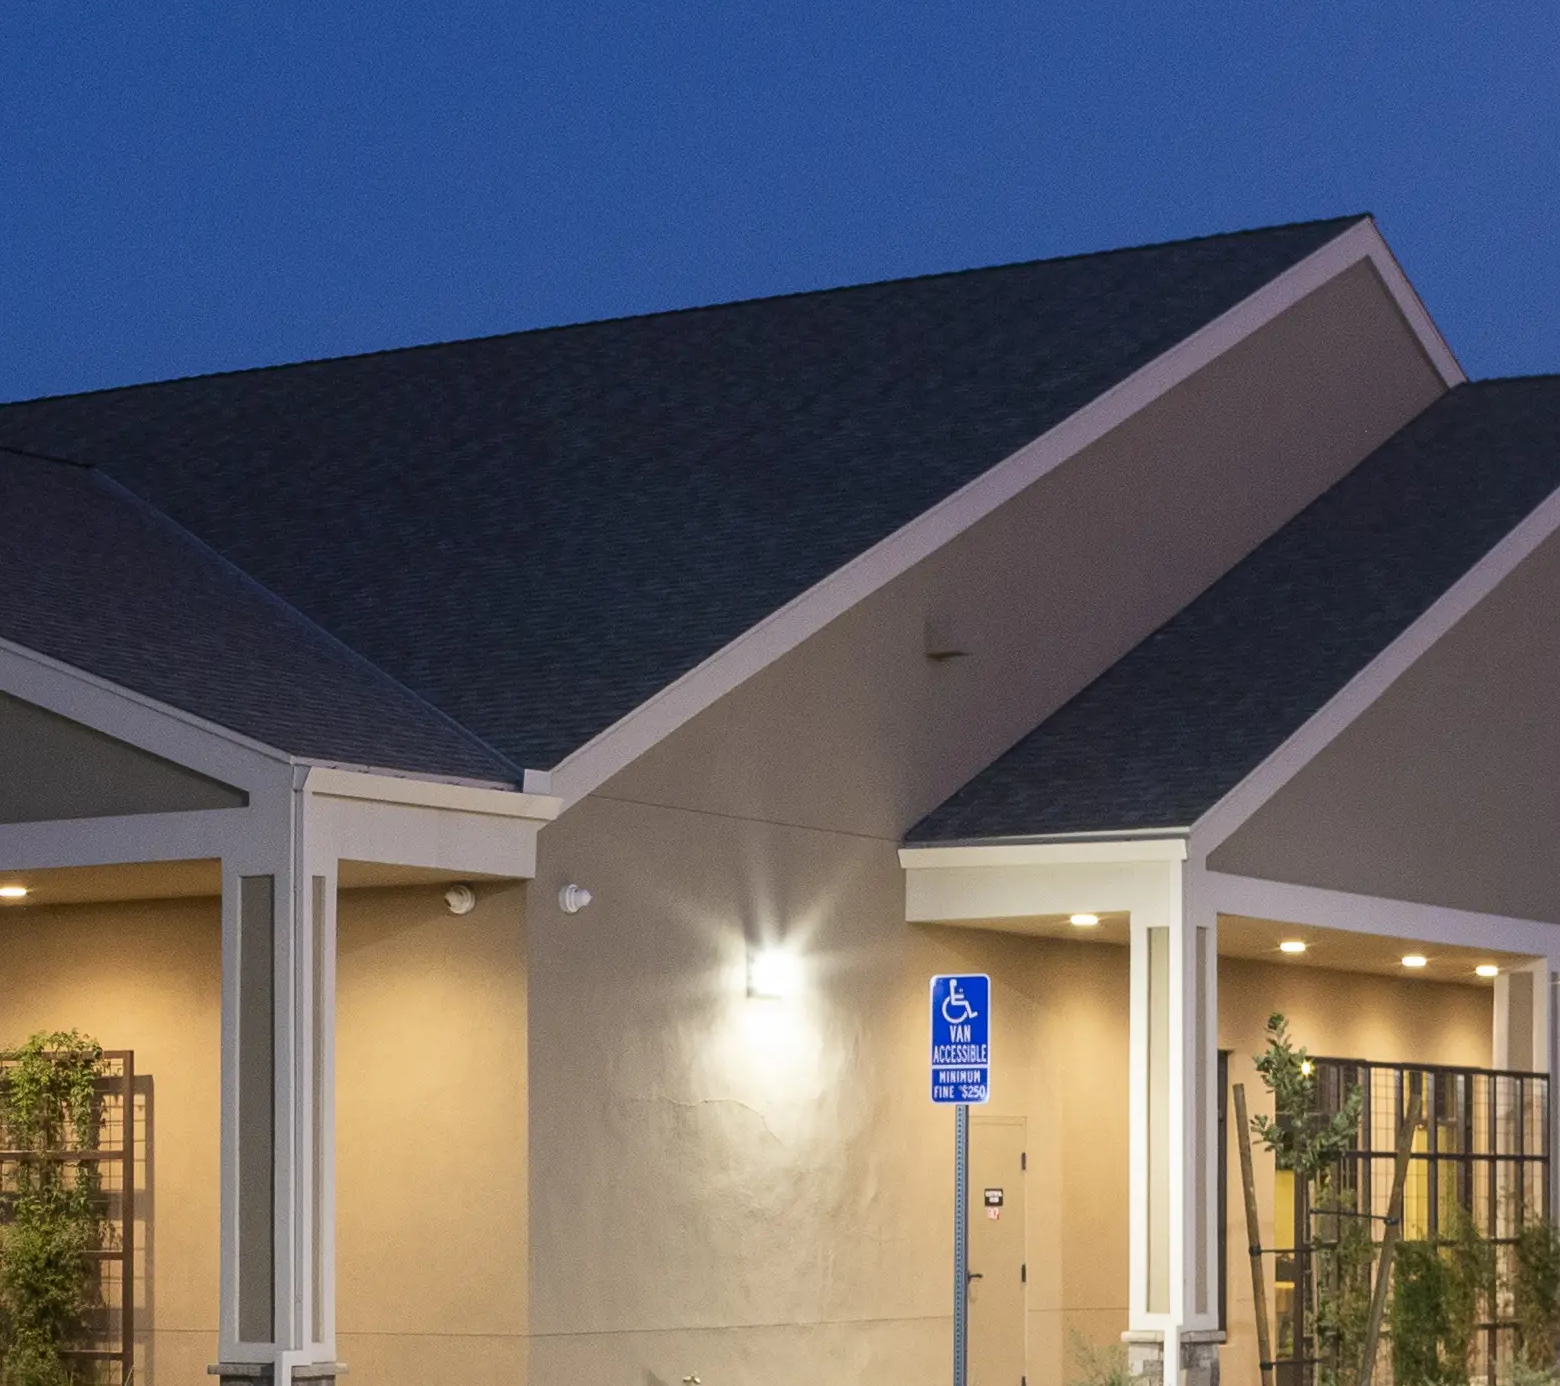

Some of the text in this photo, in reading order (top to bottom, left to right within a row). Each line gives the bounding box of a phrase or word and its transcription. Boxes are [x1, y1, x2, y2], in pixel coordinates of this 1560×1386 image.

[949, 1024, 971, 1043] VAN
[933, 1044, 987, 1063] ACCESSIBLE
[939, 1070, 981, 1083] MINIMUM
[933, 1084, 986, 1099] FINE $250
